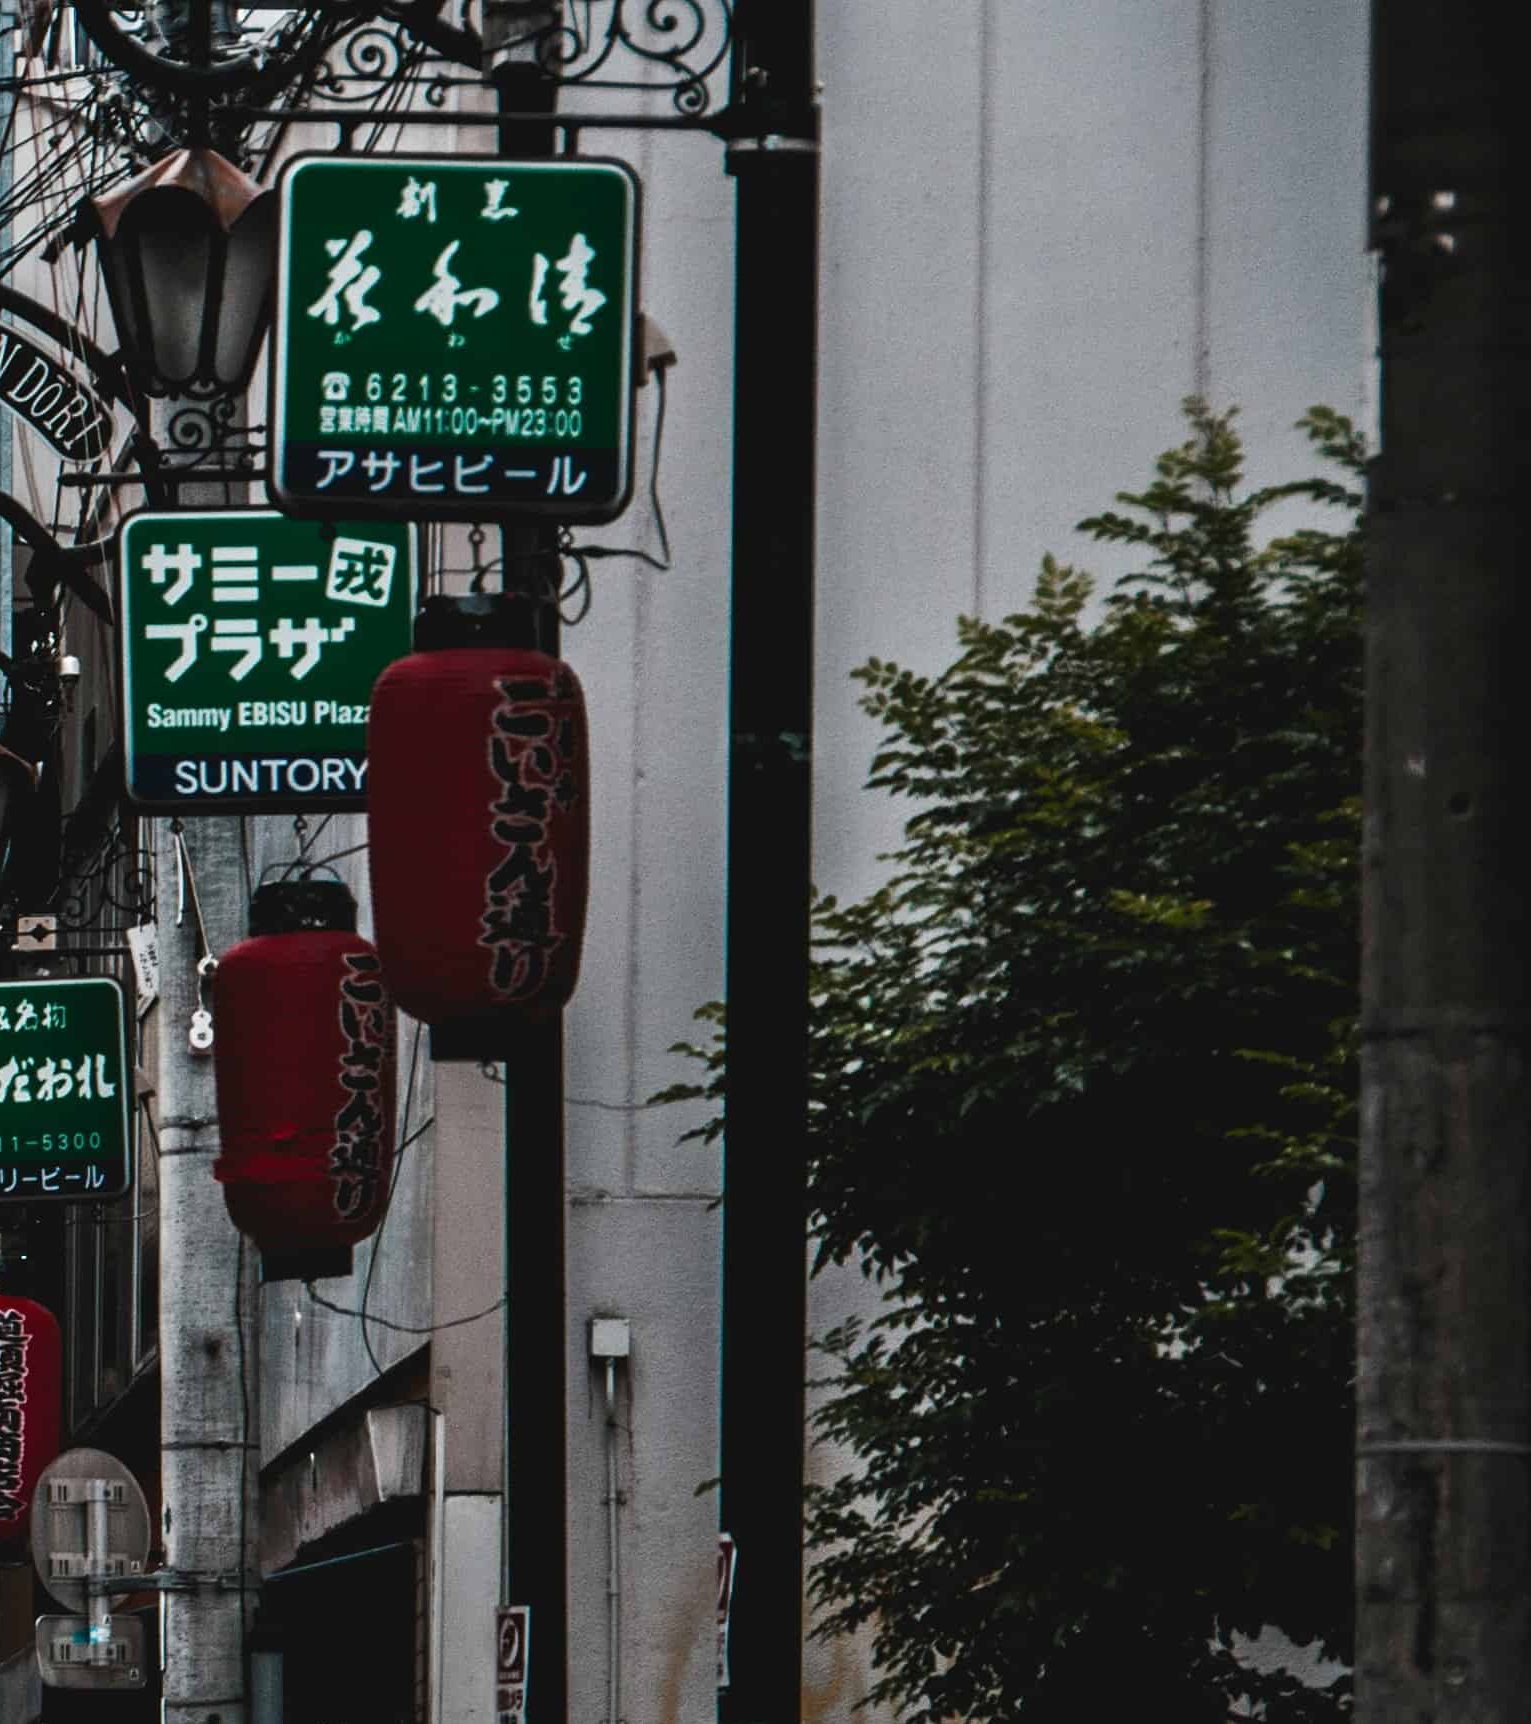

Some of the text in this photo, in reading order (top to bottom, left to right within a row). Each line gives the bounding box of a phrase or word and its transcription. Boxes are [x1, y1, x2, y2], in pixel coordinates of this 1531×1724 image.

[316, 450, 588, 496] アサヒビール
[145, 613, 356, 683] プラザ
[147, 703, 231, 732] Sammy
[238, 702, 307, 727] EBISU
[175, 758, 371, 794] SUNTORY
